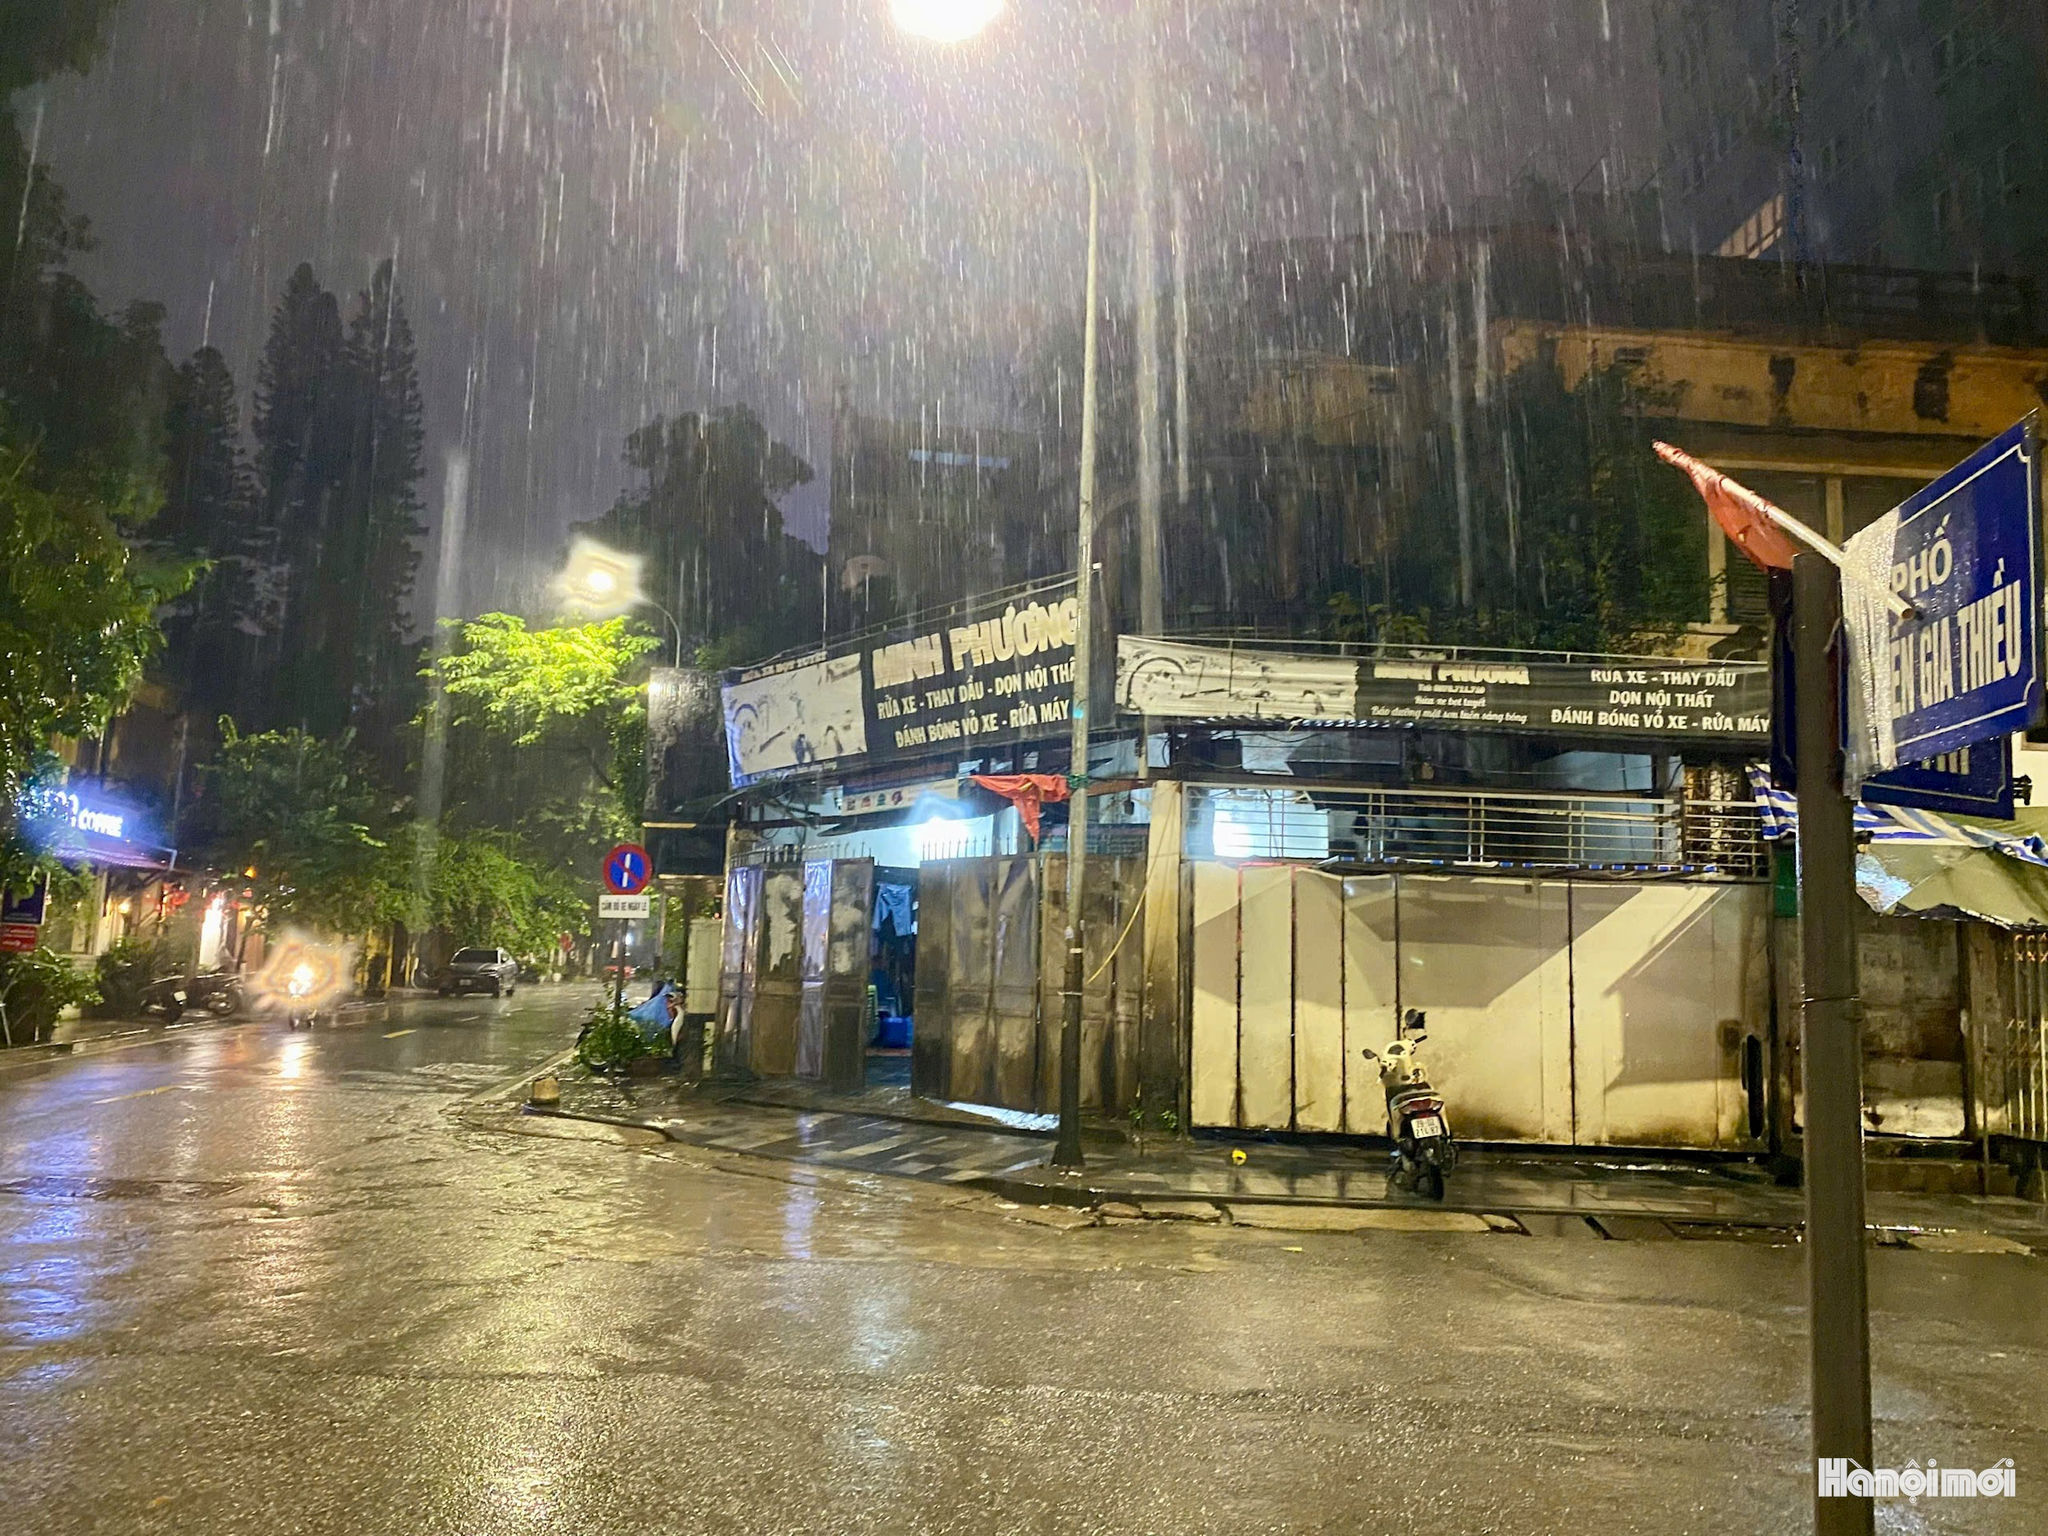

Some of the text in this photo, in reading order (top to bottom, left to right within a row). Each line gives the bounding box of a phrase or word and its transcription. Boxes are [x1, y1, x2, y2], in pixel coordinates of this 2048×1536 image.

[1889, 513, 1953, 599] PHỐ
[872, 632, 945, 690] MINH
[1627, 670, 1648, 684] XE
[1661, 671, 1701, 687] THAY
[1919, 619, 1954, 710] GIA
[877, 694, 900, 720] RỬA
[901, 695, 917, 715] XE
[925, 687, 956, 710] THAY
[994, 676, 1022, 701] DỌN
[1025, 664, 1048, 692] NỘI
[1551, 706, 1593, 725] ĐÁNH
[1597, 708, 1639, 728] BÓNG
[1643, 709, 1664, 729] VỎ
[1666, 715, 1688, 730] XE
[1702, 712, 1734, 732] RỬA
[1737, 714, 1771, 733] MÁY
[1609, 689, 1715, 708] DỌN NỘI THẤT
[895, 723, 927, 749] ĐÁNH
[928, 719, 961, 743] BÓNG
[961, 709, 980, 736] VỎ
[981, 713, 999, 734] XE
[1009, 700, 1038, 729] RỬA
[1040, 695, 1070, 721] MÁY
